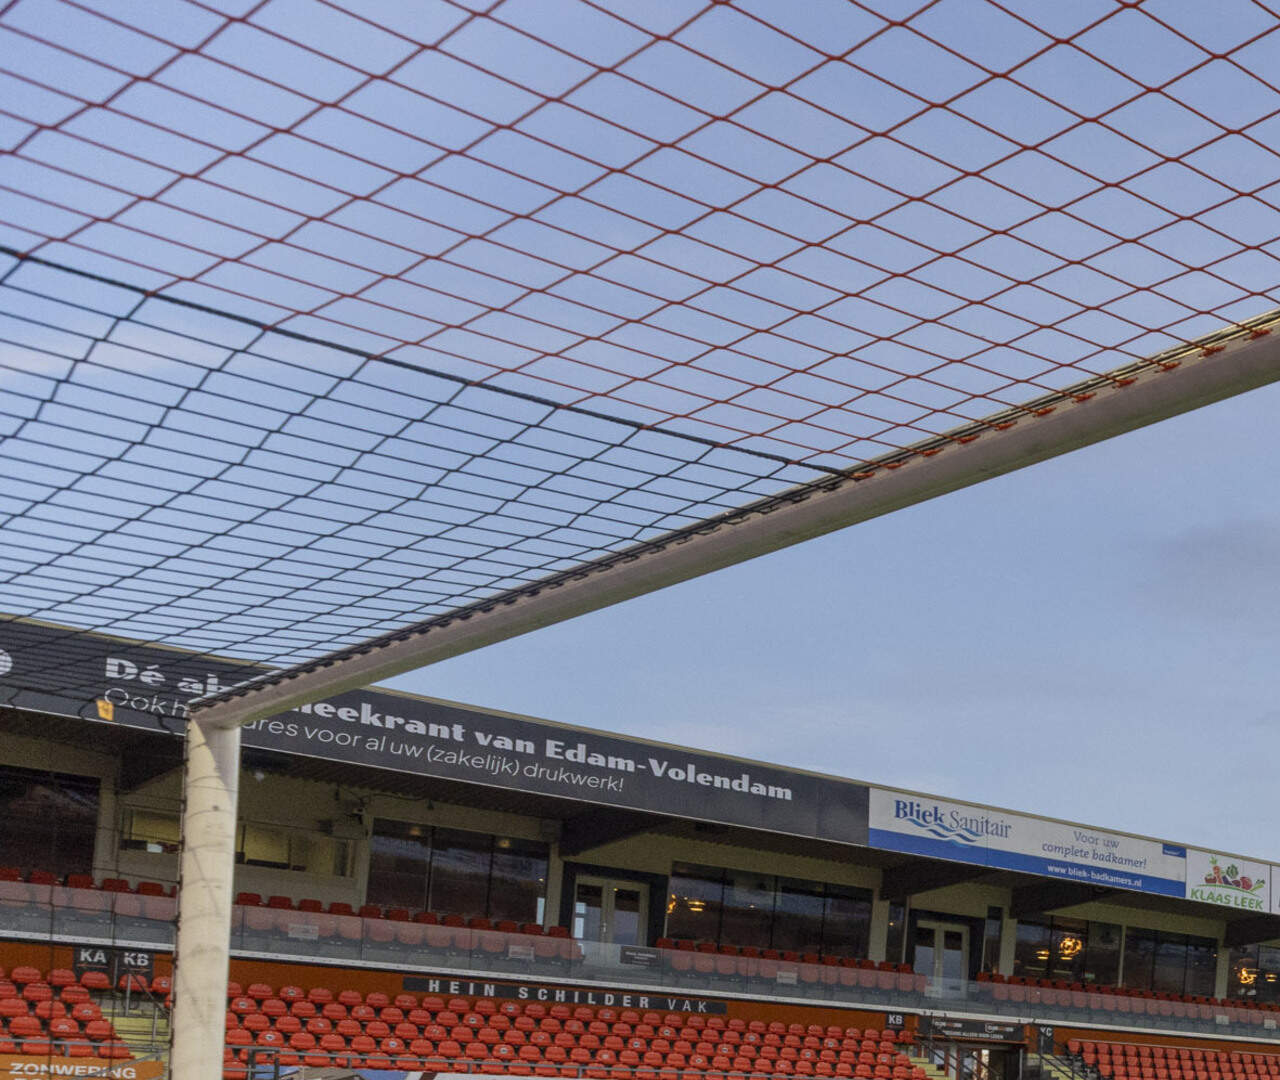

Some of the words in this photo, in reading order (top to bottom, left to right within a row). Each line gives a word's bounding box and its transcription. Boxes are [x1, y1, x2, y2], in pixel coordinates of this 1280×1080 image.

[105, 657, 165, 687] Dé
[475, 730, 535, 755] van
[545, 739, 793, 801] Edam-Volendam
[105, 688, 166, 715] Ook
[304, 726, 362, 748] voor
[365, 736, 387, 752] al
[390, 743, 424, 758] uw
[426, 745, 520, 777] (zakelijk)
[524, 762, 624, 793] drukwerk!
[894, 799, 945, 826] Bliek
[949, 811, 1012, 840] Sanitair
[1073, 830, 1097, 846] Voor
[1101, 837, 1120, 850] uw
[1042, 841, 1089, 860] complete
[1092, 850, 1147, 870] badkamer!
[1190, 888, 1231, 906] KLAAS
[1234, 895, 1264, 911] LEEK
[80, 948, 107, 964] KA
[124, 951, 150, 967] KB
[429, 978, 496, 997] HEIN
[518, 986, 650, 1010] SCHILDER
[668, 998, 708, 1014] VAK
